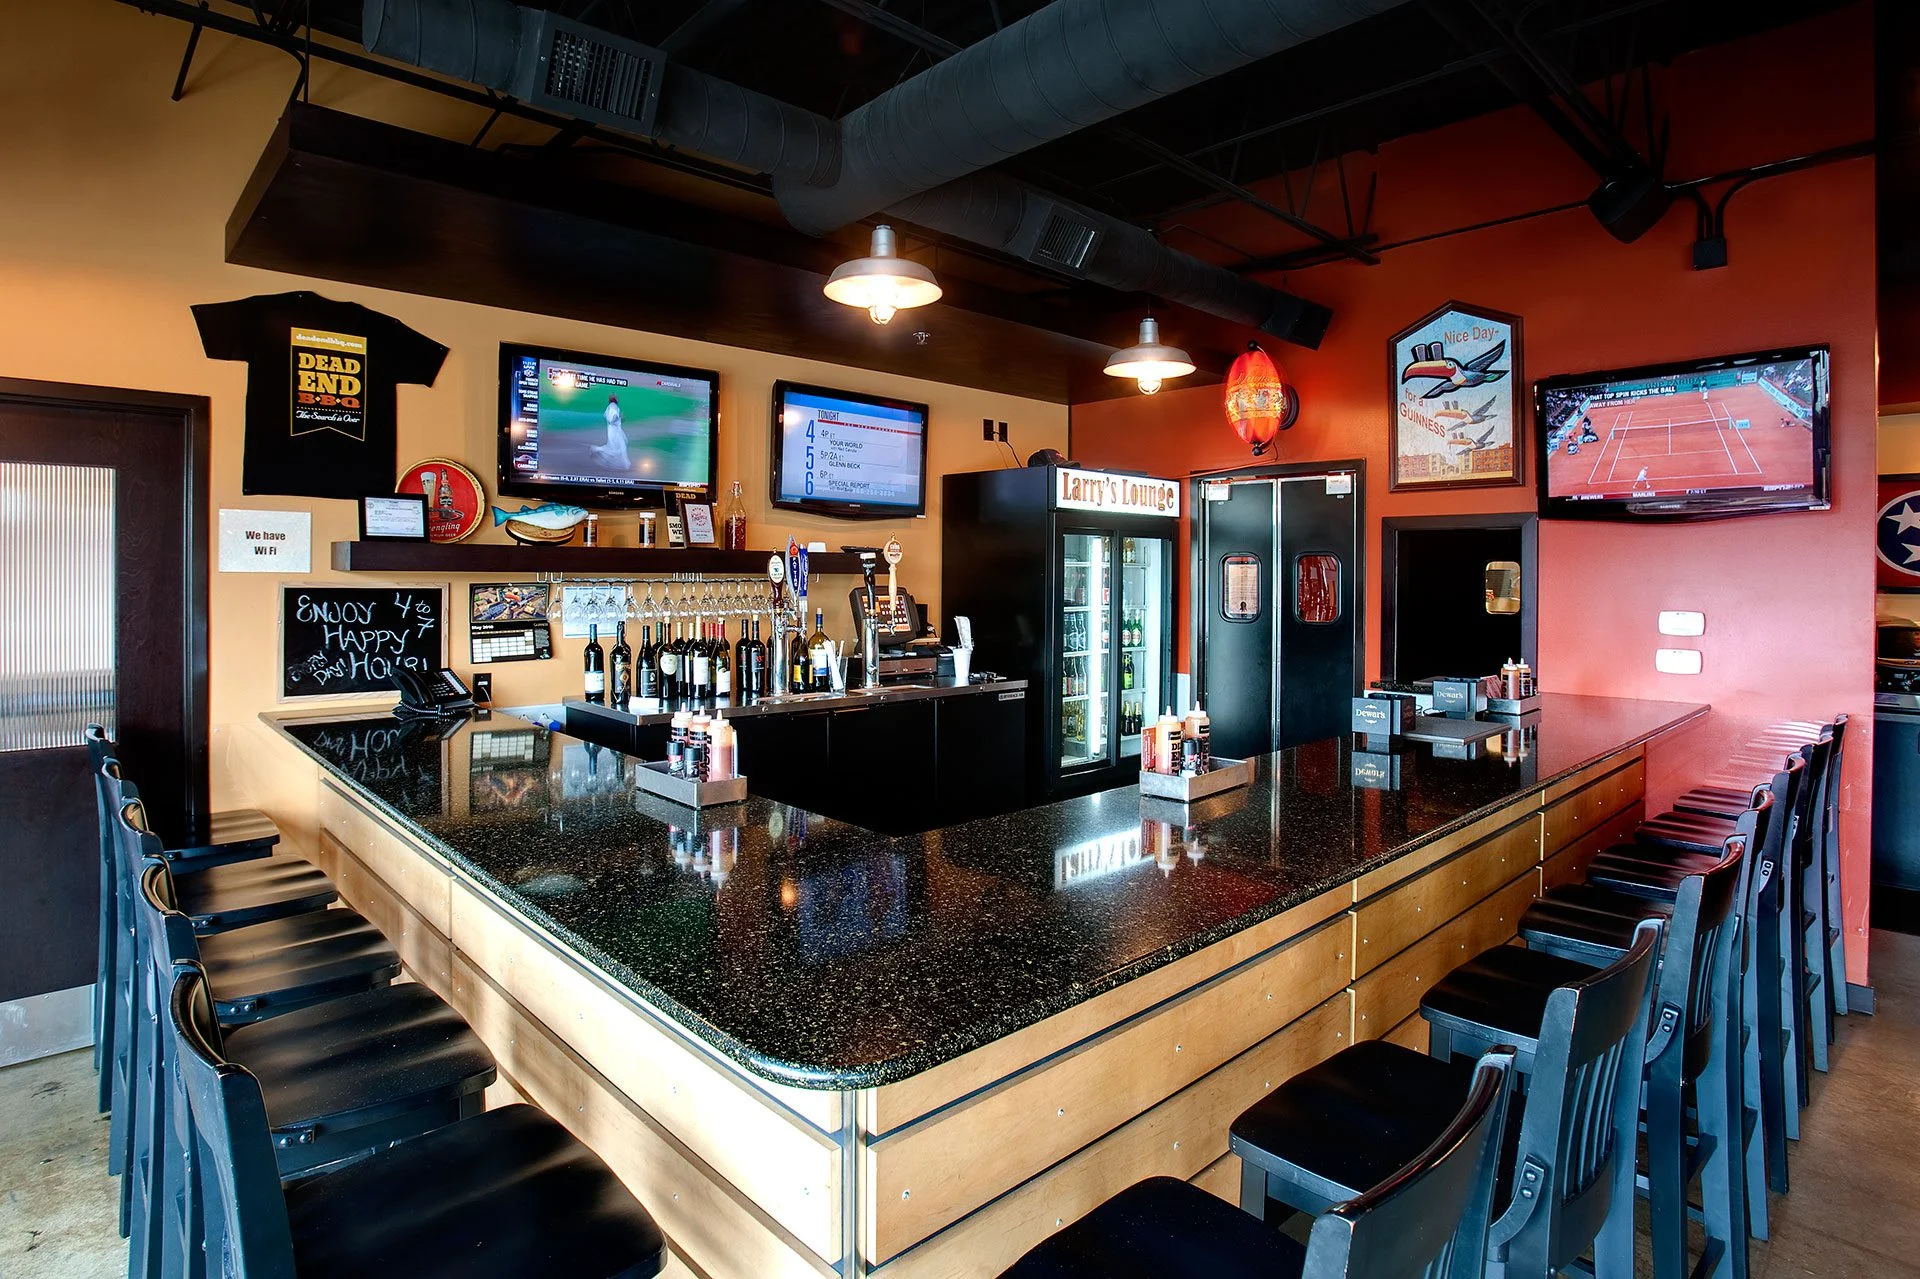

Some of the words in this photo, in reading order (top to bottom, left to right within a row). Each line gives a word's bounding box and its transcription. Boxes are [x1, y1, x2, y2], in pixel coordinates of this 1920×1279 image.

[1444, 330, 1468, 344] Nice
[298, 352, 361, 374] DEAD
[298, 370, 361, 396] END
[1660, 386, 1676, 394] BALL
[1405, 388, 1417, 402] for
[296, 410, 310, 420] The
[311, 412, 336, 421] Search
[337, 414, 342, 422] is
[343, 414, 360, 422] Over
[818, 410, 839, 421] TONIGHT
[1400, 403, 1446, 438] GUINNESS
[806, 420, 815, 443] 4
[806, 446, 814, 470] 5
[805, 471, 814, 495] 6
[820, 470, 828, 478] 6P
[1063, 472, 1116, 506] Larry's
[1122, 479, 1174, 511] Lounge
[246, 531, 260, 540] We
[263, 531, 286, 540] have
[429, 522, 461, 532] engling
[297, 595, 377, 624] ENJOY
[394, 592, 412, 618] 4
[416, 600, 430, 614] to
[417, 615, 435, 638] 7
[323, 624, 409, 654] HAPPY
[1355, 709, 1386, 719] Dewar's
